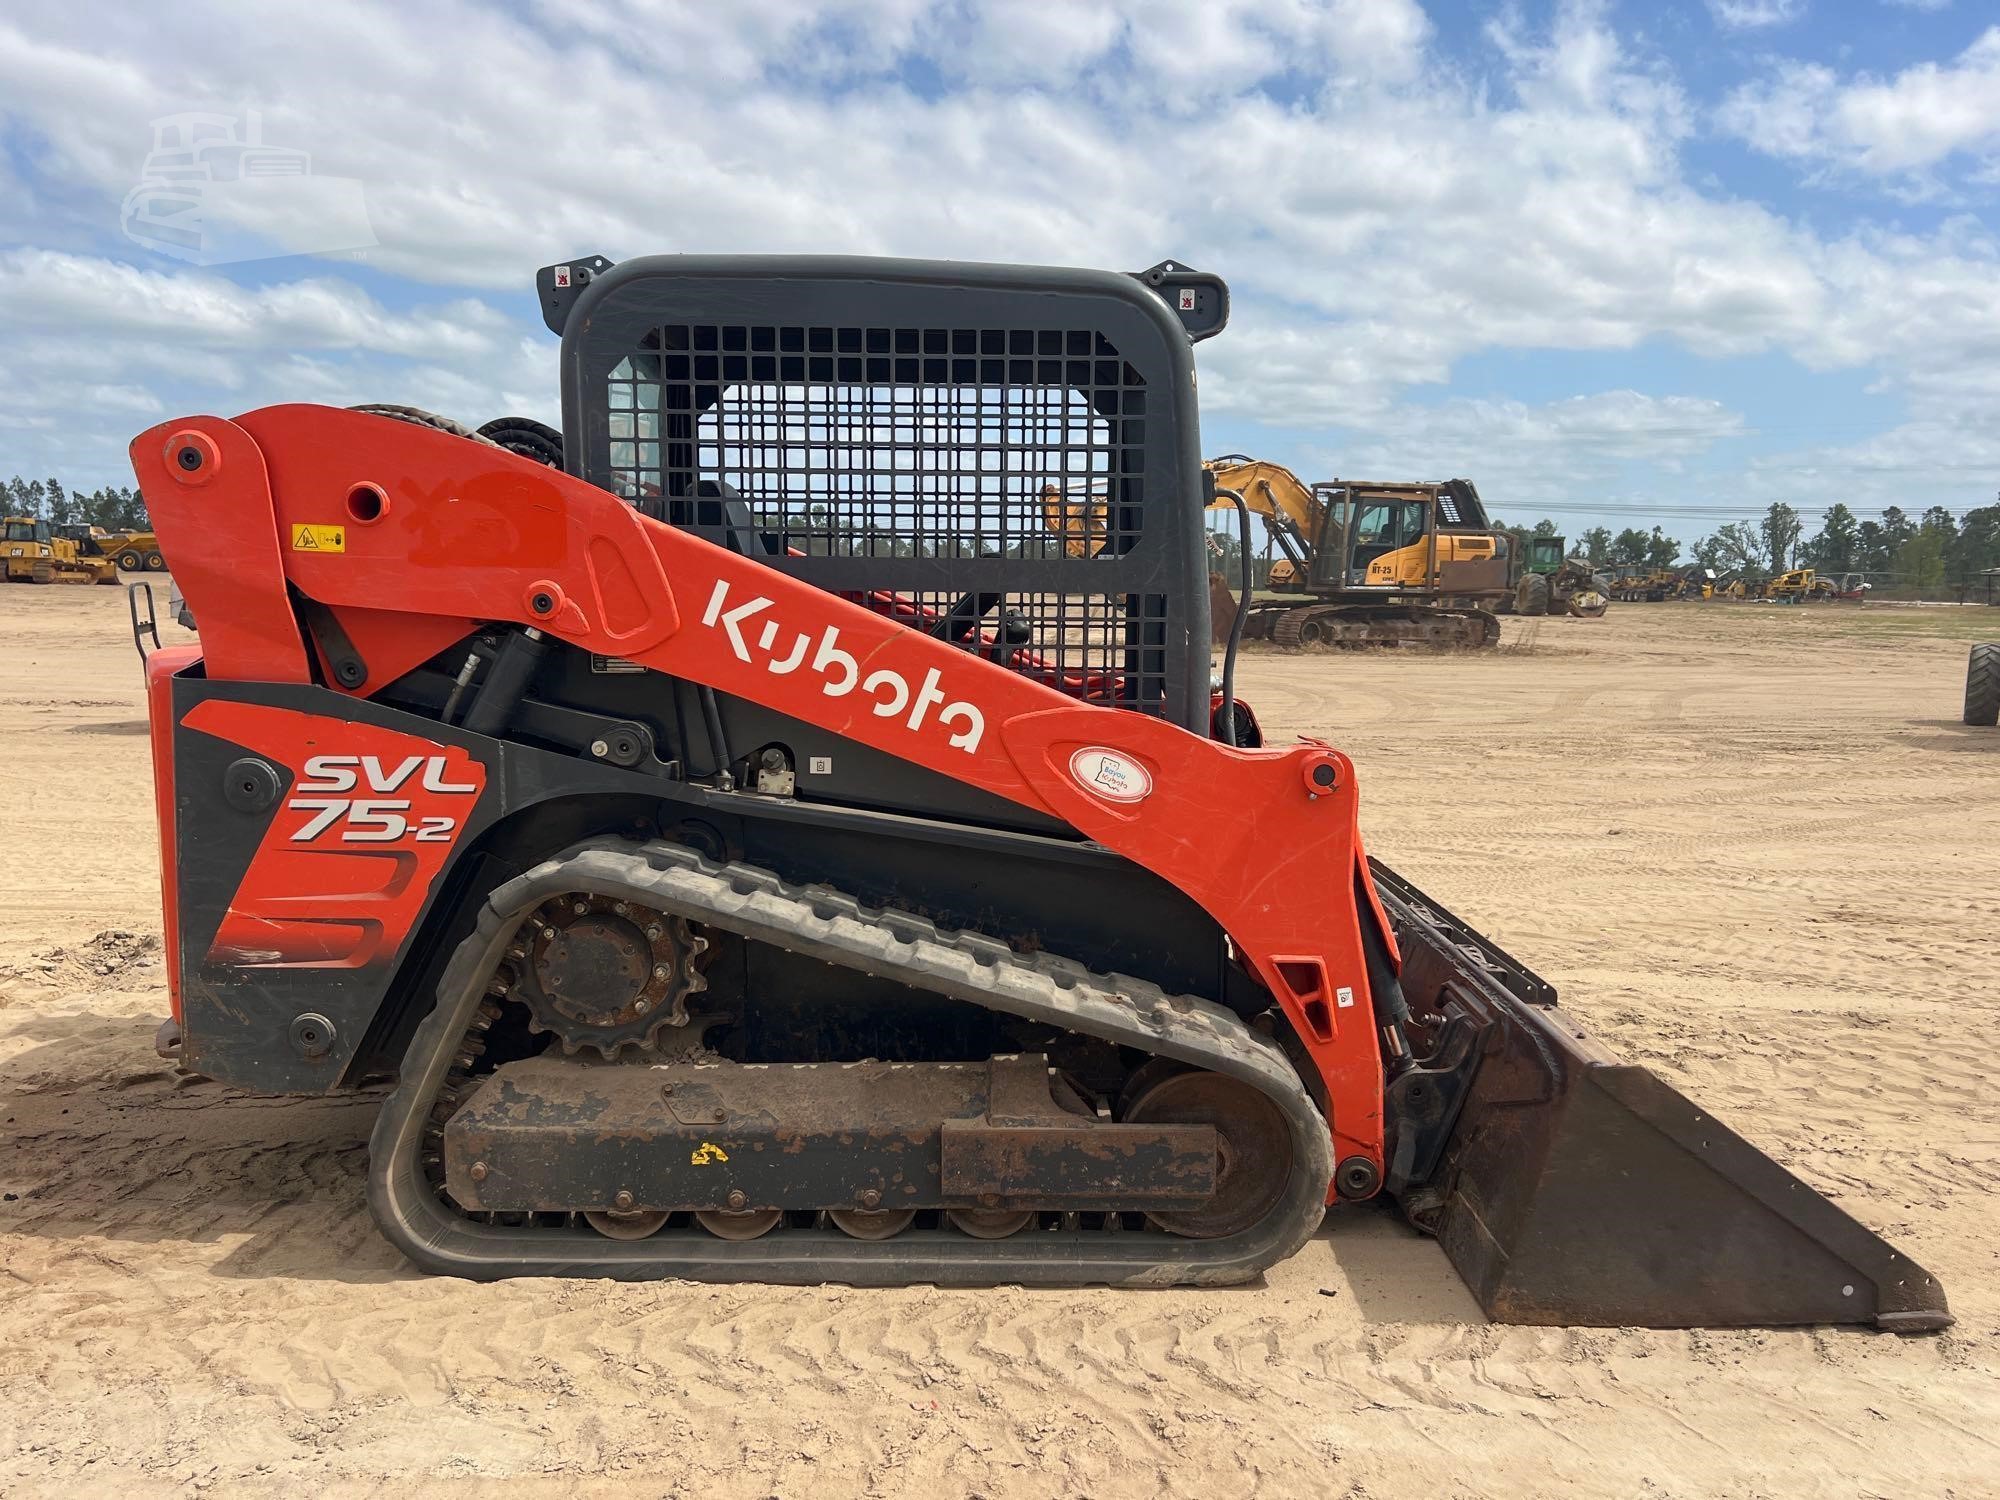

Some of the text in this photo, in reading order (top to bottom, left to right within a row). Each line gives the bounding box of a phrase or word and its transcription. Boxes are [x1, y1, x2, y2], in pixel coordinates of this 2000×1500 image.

[701, 578, 985, 755] Kubota
[296, 755, 476, 794] SVL
[1104, 766, 1126, 780] Bayou
[288, 799, 456, 843] 75-2
